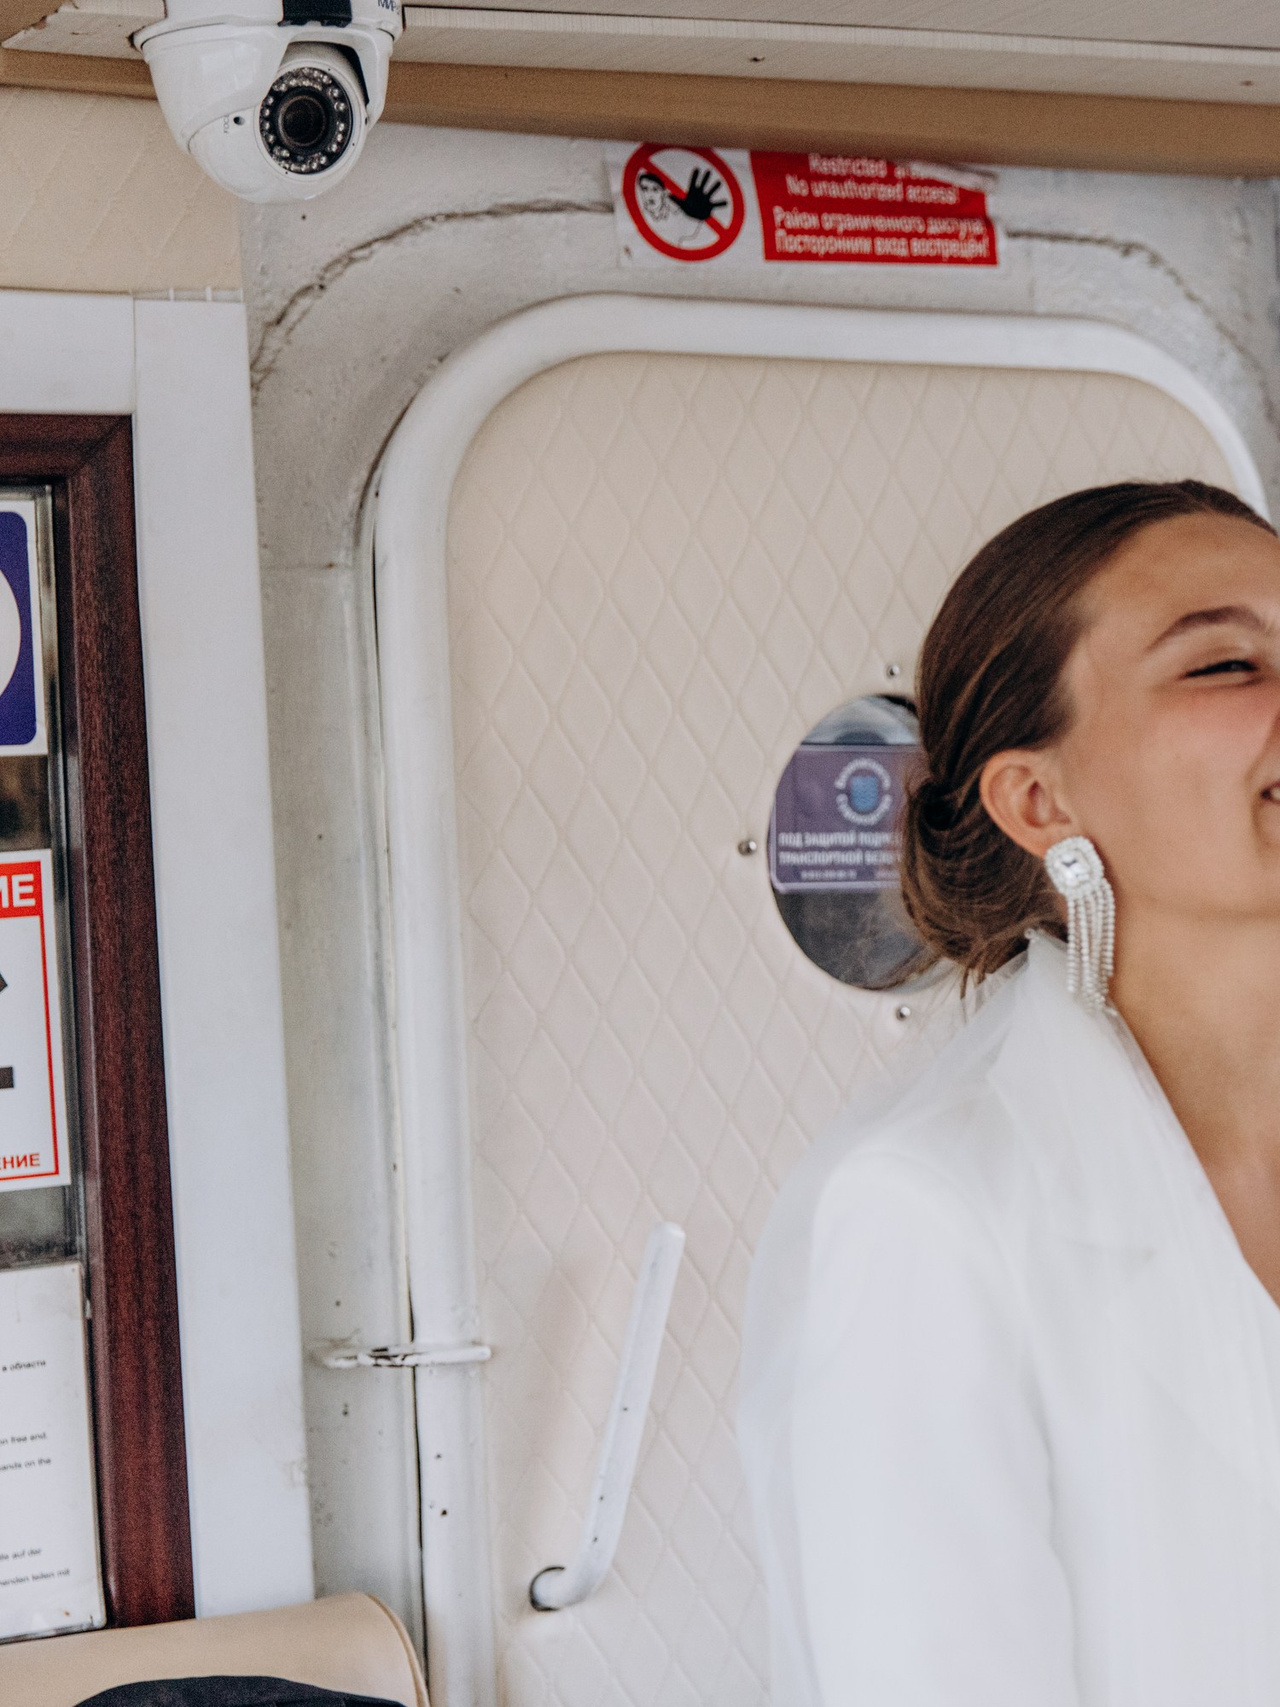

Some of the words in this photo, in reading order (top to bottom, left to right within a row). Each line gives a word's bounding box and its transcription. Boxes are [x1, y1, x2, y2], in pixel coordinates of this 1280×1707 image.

[785, 173, 809, 197] No
[811, 178, 904, 201] unauthorized
[773, 205, 820, 230] Район
[821, 212, 926, 235] ограниченного
[775, 229, 873, 257] Посторонним
[874, 236, 909, 258] вход
